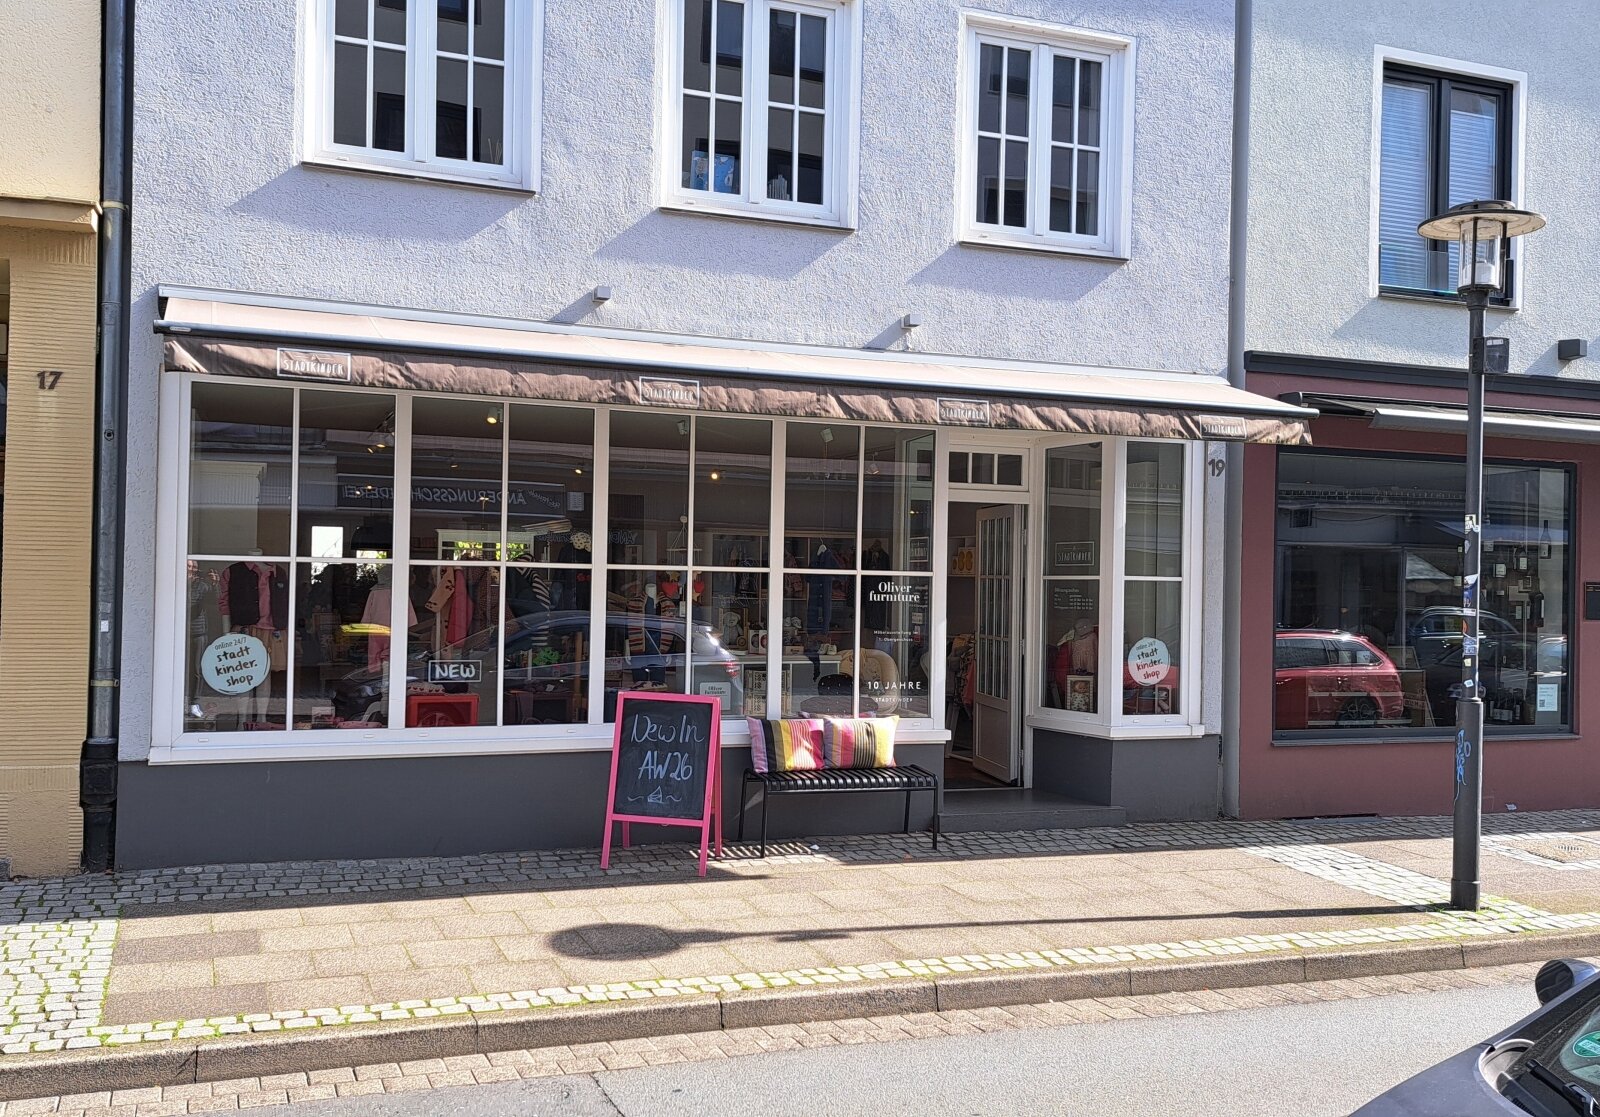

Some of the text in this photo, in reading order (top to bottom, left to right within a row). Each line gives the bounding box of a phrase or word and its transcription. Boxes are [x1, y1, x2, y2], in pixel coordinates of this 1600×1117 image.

[283, 359, 344, 375] STADTKINDER
[37, 371, 64, 389] 17
[1208, 459, 1225, 477] 19
[878, 581, 912, 593] Oliver
[869, 590, 920, 602] furniture
[215, 637, 247, 651] online 24/7
[217, 646, 250, 662] stadt
[1137, 647, 1158, 660] stadt
[215, 660, 258, 676] kinder.
[435, 664, 476, 680] NEW
[1136, 658, 1163, 671] kinder.
[226, 675, 254, 687] shop
[1143, 670, 1160, 679] shop
[867, 681, 921, 690] 10 JAHRE
[631, 714, 706, 744] New In
[638, 750, 693, 781] AW26
